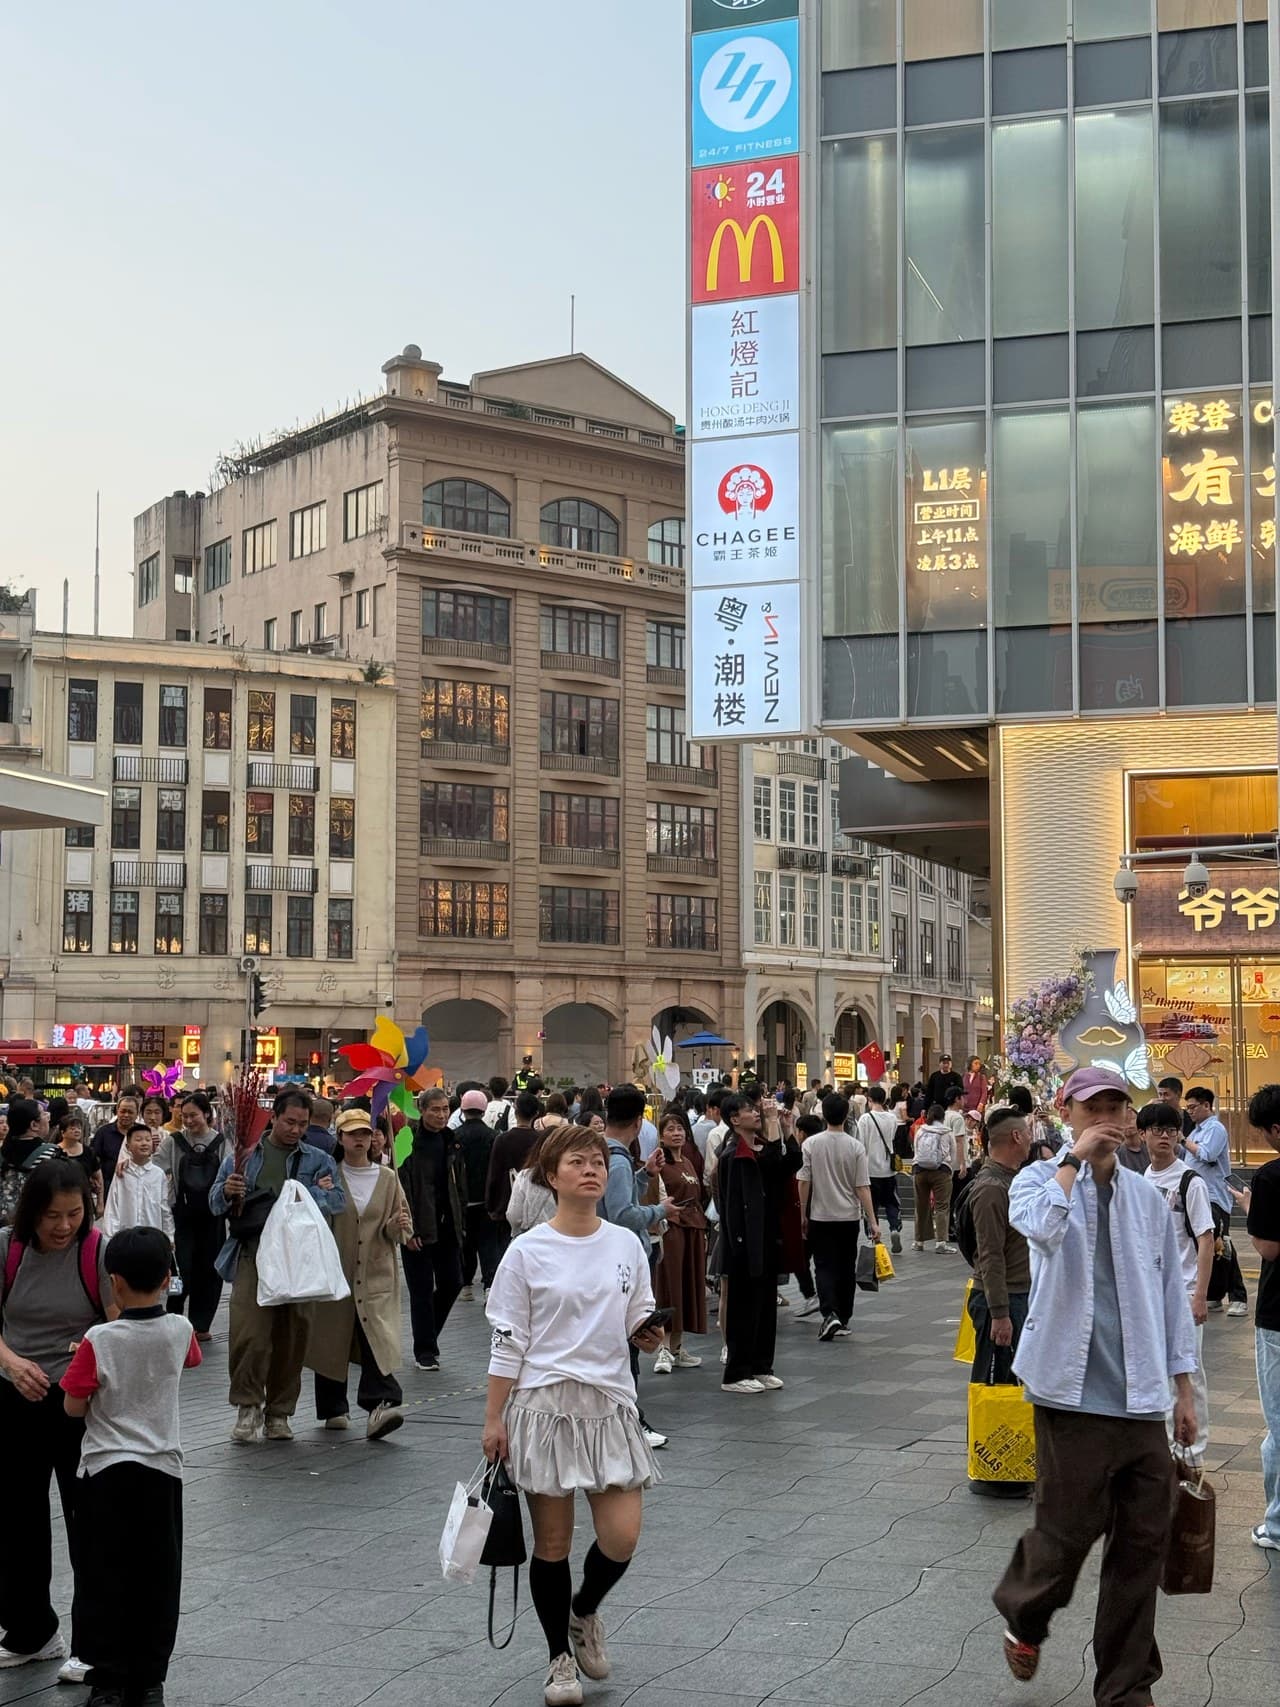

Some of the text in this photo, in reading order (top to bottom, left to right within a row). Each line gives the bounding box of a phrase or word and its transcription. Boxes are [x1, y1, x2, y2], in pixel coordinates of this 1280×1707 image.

[699, 136, 793, 158] 24/7 FITNESS
[746, 168, 785, 198] 24
[730, 310, 760, 399] 紅燈記
[700, 399, 790, 418] HONG DENG JI
[1169, 400, 1236, 436] 荣登
[920, 504, 973, 520] 营业时间
[696, 526, 796, 547] CHAGEE
[713, 546, 778, 562] 霸王茶姬
[1178, 887, 1279, 931] 爷爷
[1155, 997, 1195, 1011] Happy
[1201, 1013, 1230, 1025] Year
[974, 1440, 1003, 1472] KAILAS
